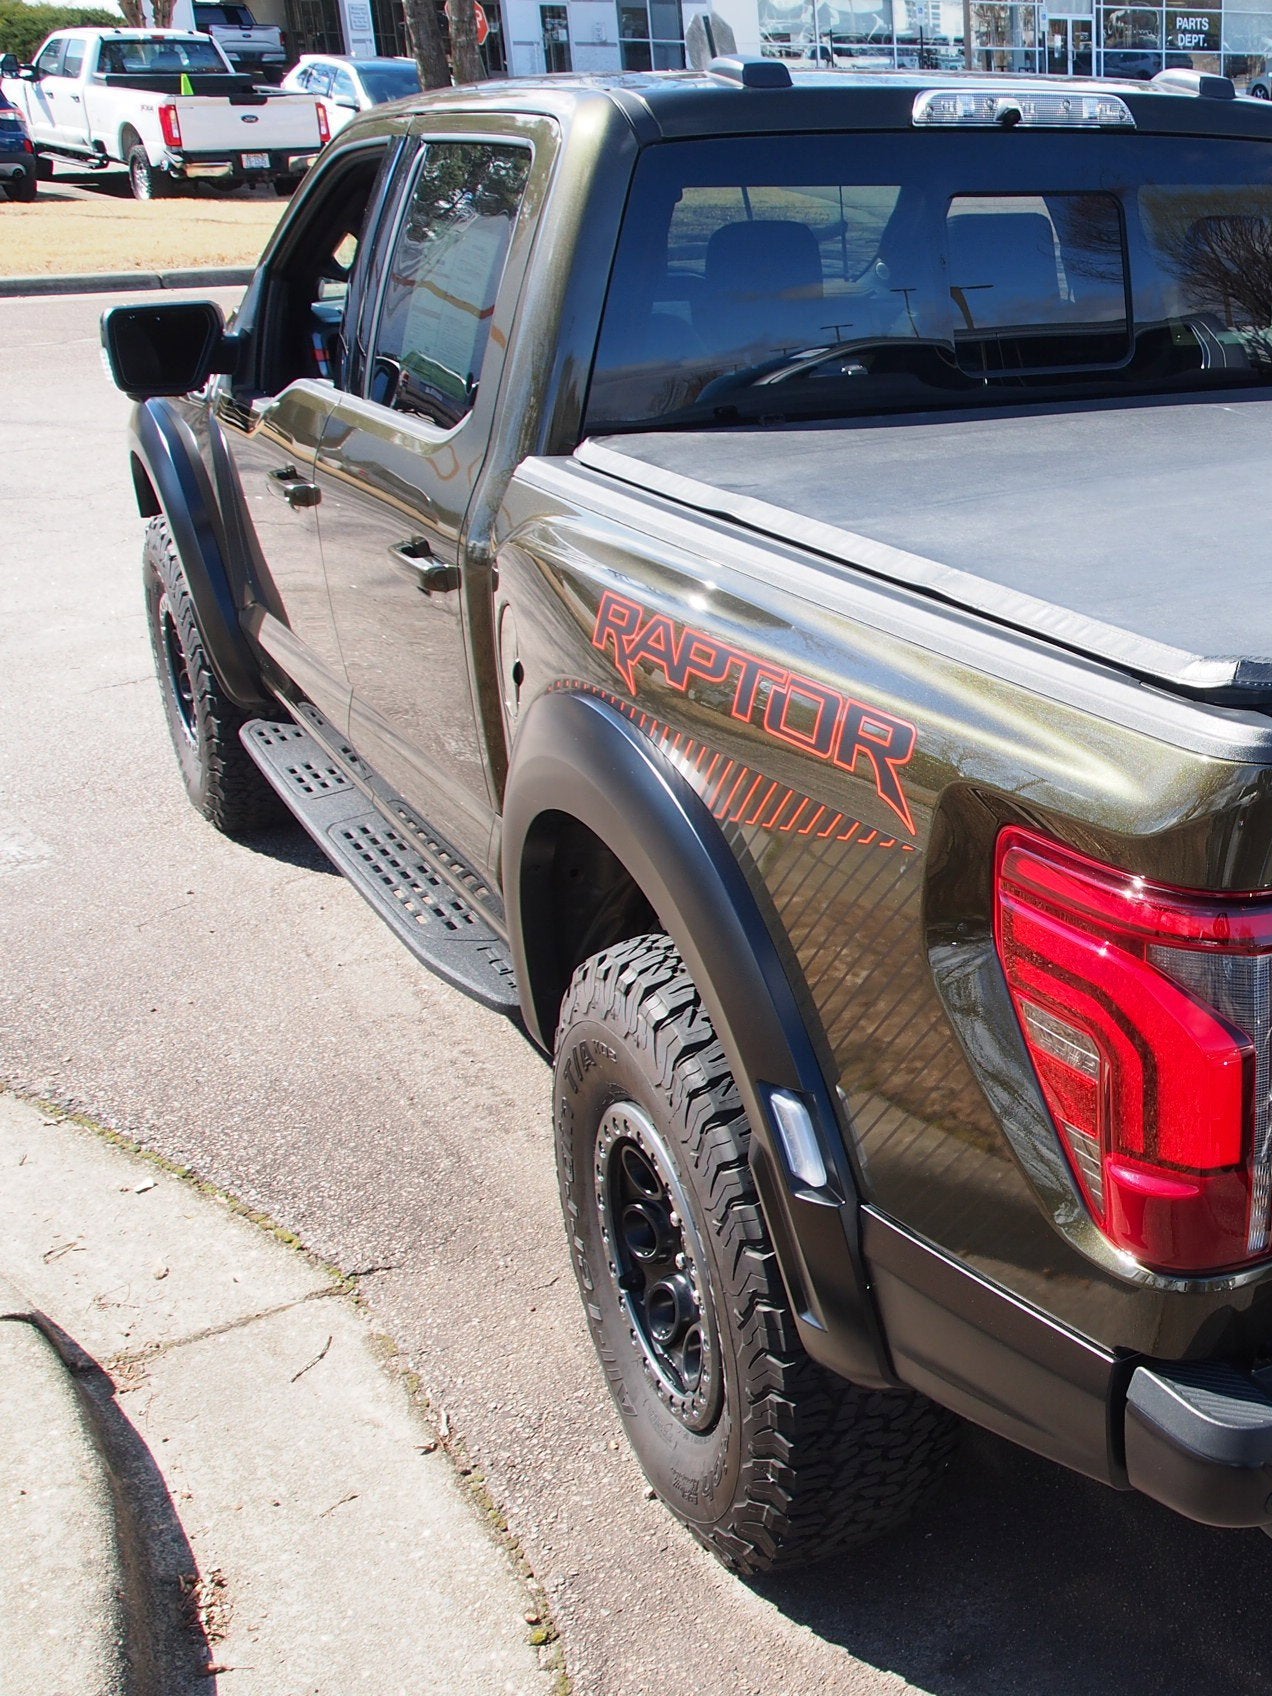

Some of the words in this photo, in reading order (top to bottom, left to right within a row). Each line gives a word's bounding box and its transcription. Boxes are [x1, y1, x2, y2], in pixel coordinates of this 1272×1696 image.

[1176, 17, 1209, 31] PARTS
[1178, 34, 1208, 47] DEPT.
[592, 590, 918, 836] RAPTOR
